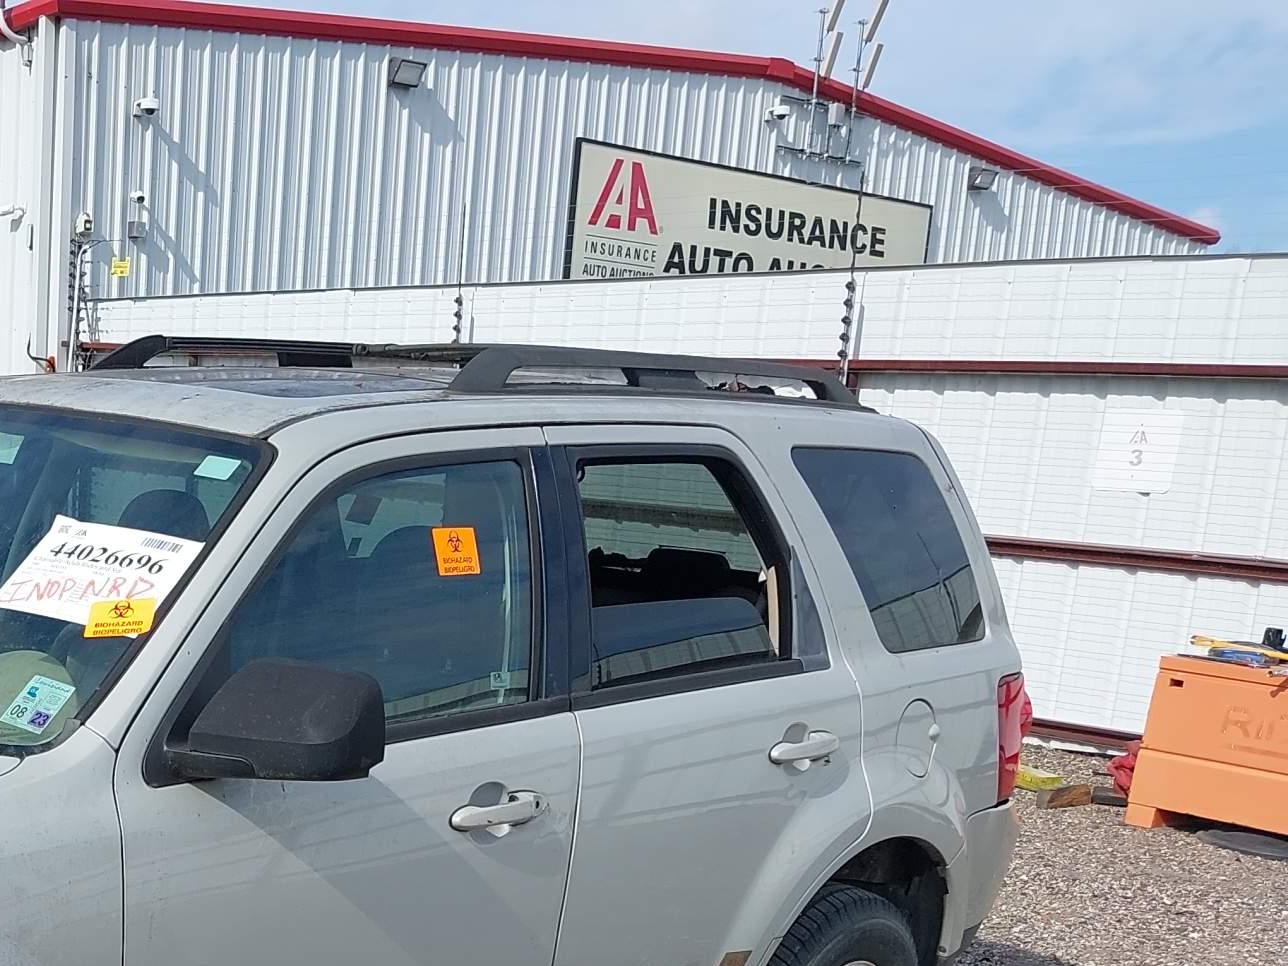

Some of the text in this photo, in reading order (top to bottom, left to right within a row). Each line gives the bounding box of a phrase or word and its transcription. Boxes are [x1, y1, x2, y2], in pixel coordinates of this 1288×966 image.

[708, 197, 887, 258] INSURANCE
[584, 240, 657, 263] INSURANCE
[662, 241, 755, 275] AUTO
[582, 263, 608, 278] AUTO
[1128, 449, 1144, 467] 3
[49, 541, 169, 576] 44026696
[94, 620, 144, 629] BIOHAZARD
[9, 704, 50, 726] 08 23
